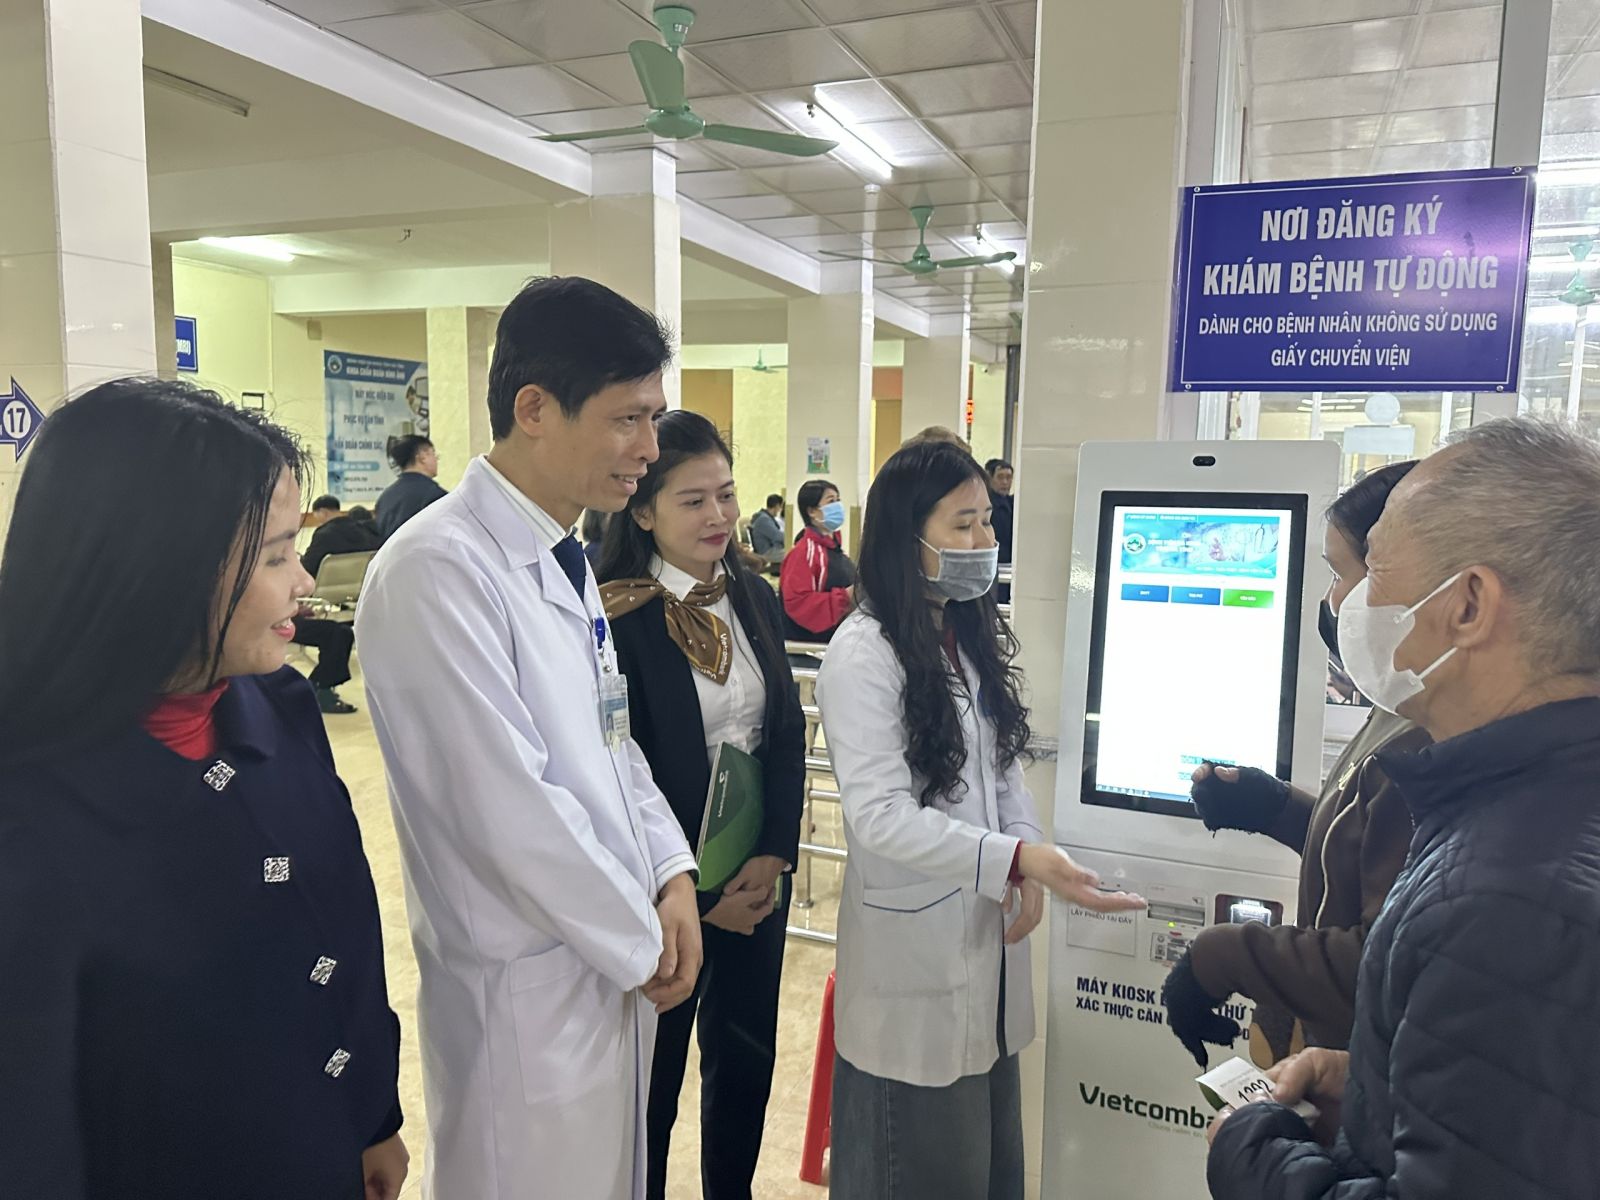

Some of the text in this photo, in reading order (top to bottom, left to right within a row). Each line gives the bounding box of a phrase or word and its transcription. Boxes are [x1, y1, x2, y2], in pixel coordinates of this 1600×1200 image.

[1260, 195, 1443, 242] NƠI ĐĂNG KÝ
[1202, 250, 1499, 300] KHÁM BỆNH TỰ ĐỘNG
[1198, 306, 1498, 338] DÀNH CHO BỆNH NHÂN KHÔNG SỬ DỤNG
[1270, 338, 1411, 371] GIẤY CHUYỂN VIỆN
[7, 407, 26, 433] 17
[1076, 976, 1108, 996] MÁY
[1112, 983, 1156, 1005] KIOSK
[1076, 996, 1163, 1025] XÁC THỰC CĂN
